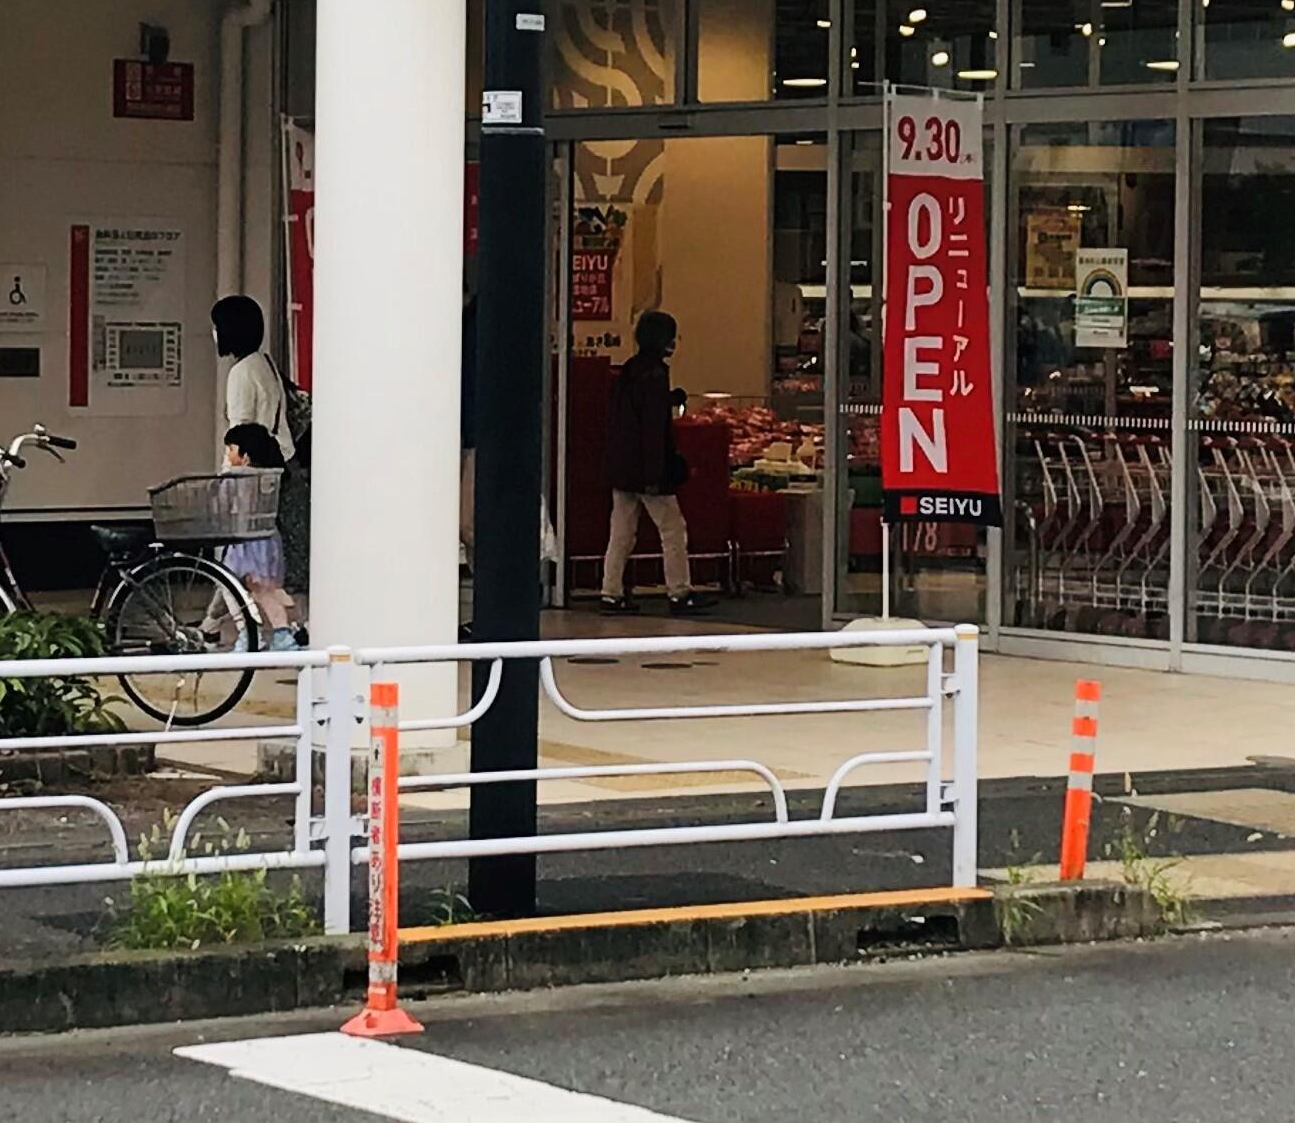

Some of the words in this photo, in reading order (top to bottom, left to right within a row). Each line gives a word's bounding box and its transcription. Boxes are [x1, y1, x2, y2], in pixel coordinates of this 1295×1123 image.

[897, 116, 961, 163] 9.30
[573, 255, 608, 270] EIYU
[948, 197, 974, 396] リニューアル
[899, 192, 948, 473] OPEN
[919, 496, 982, 516] SEIYU
